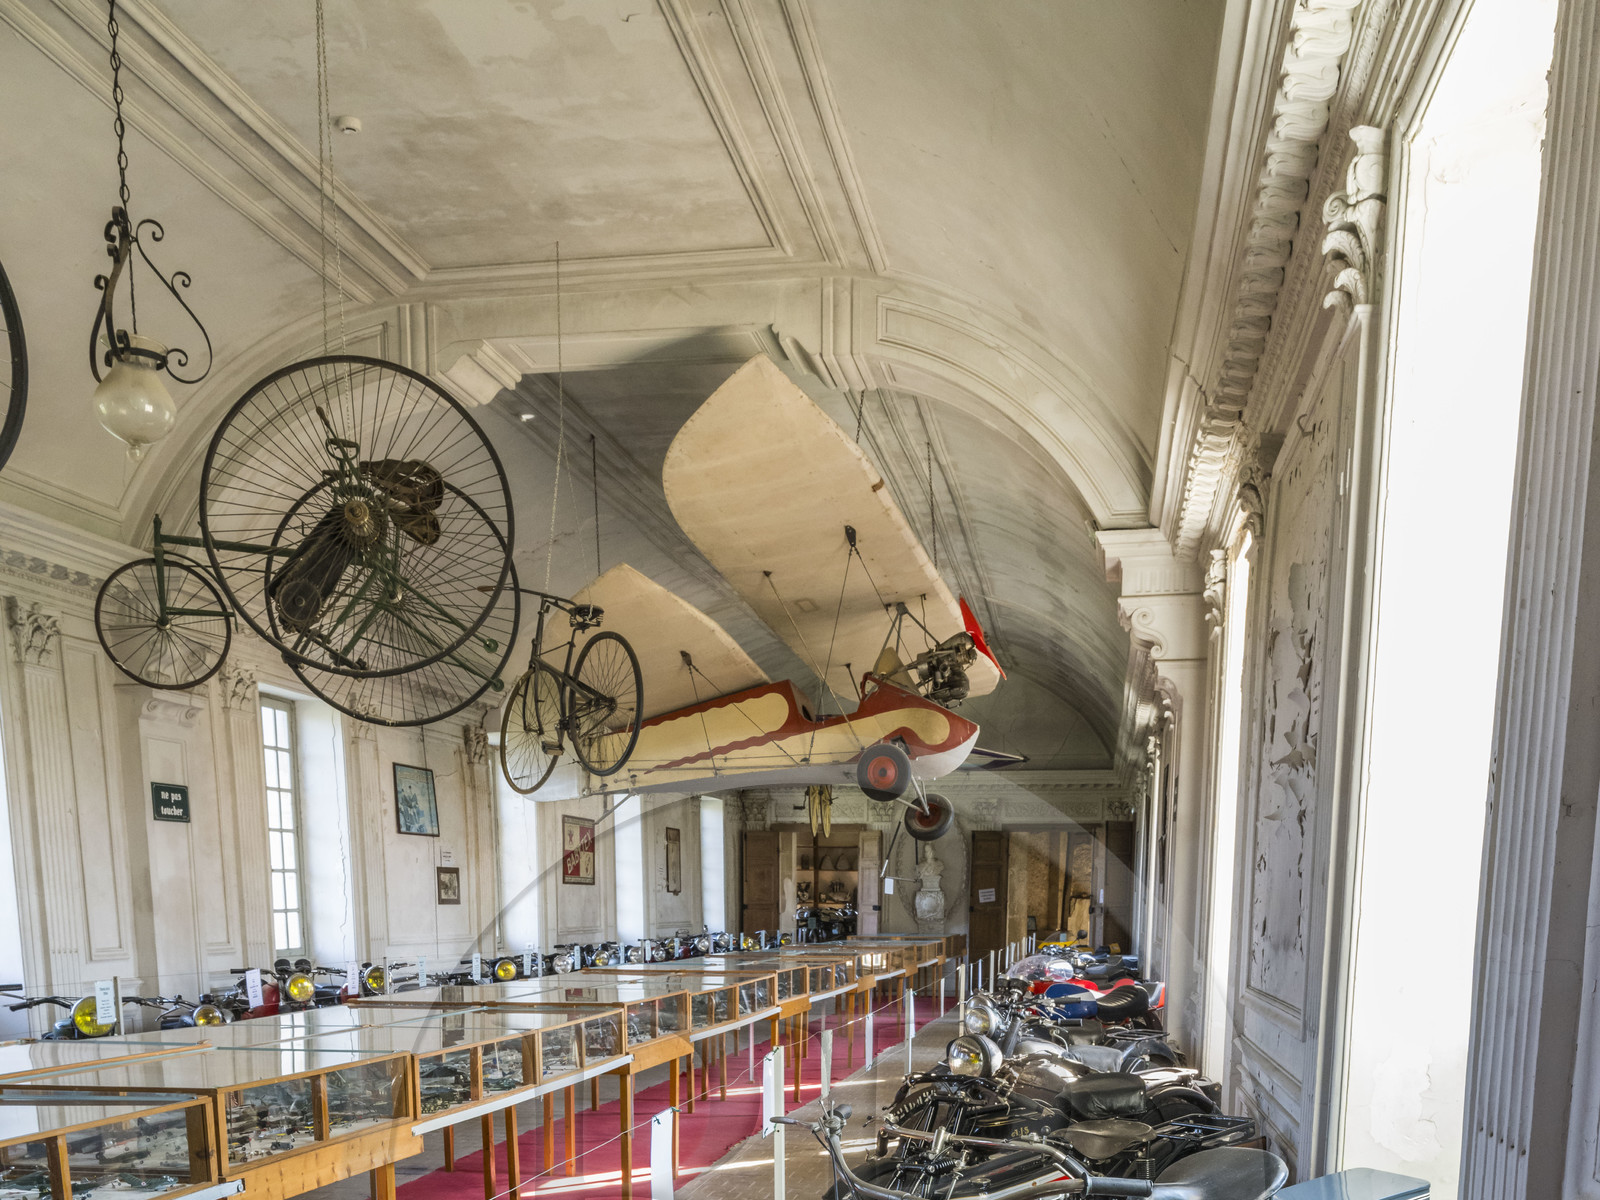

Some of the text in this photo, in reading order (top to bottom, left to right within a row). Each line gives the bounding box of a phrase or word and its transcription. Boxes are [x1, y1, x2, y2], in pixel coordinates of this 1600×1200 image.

[161, 791, 182, 803] ne pas
[161, 805, 183, 816] toucher
